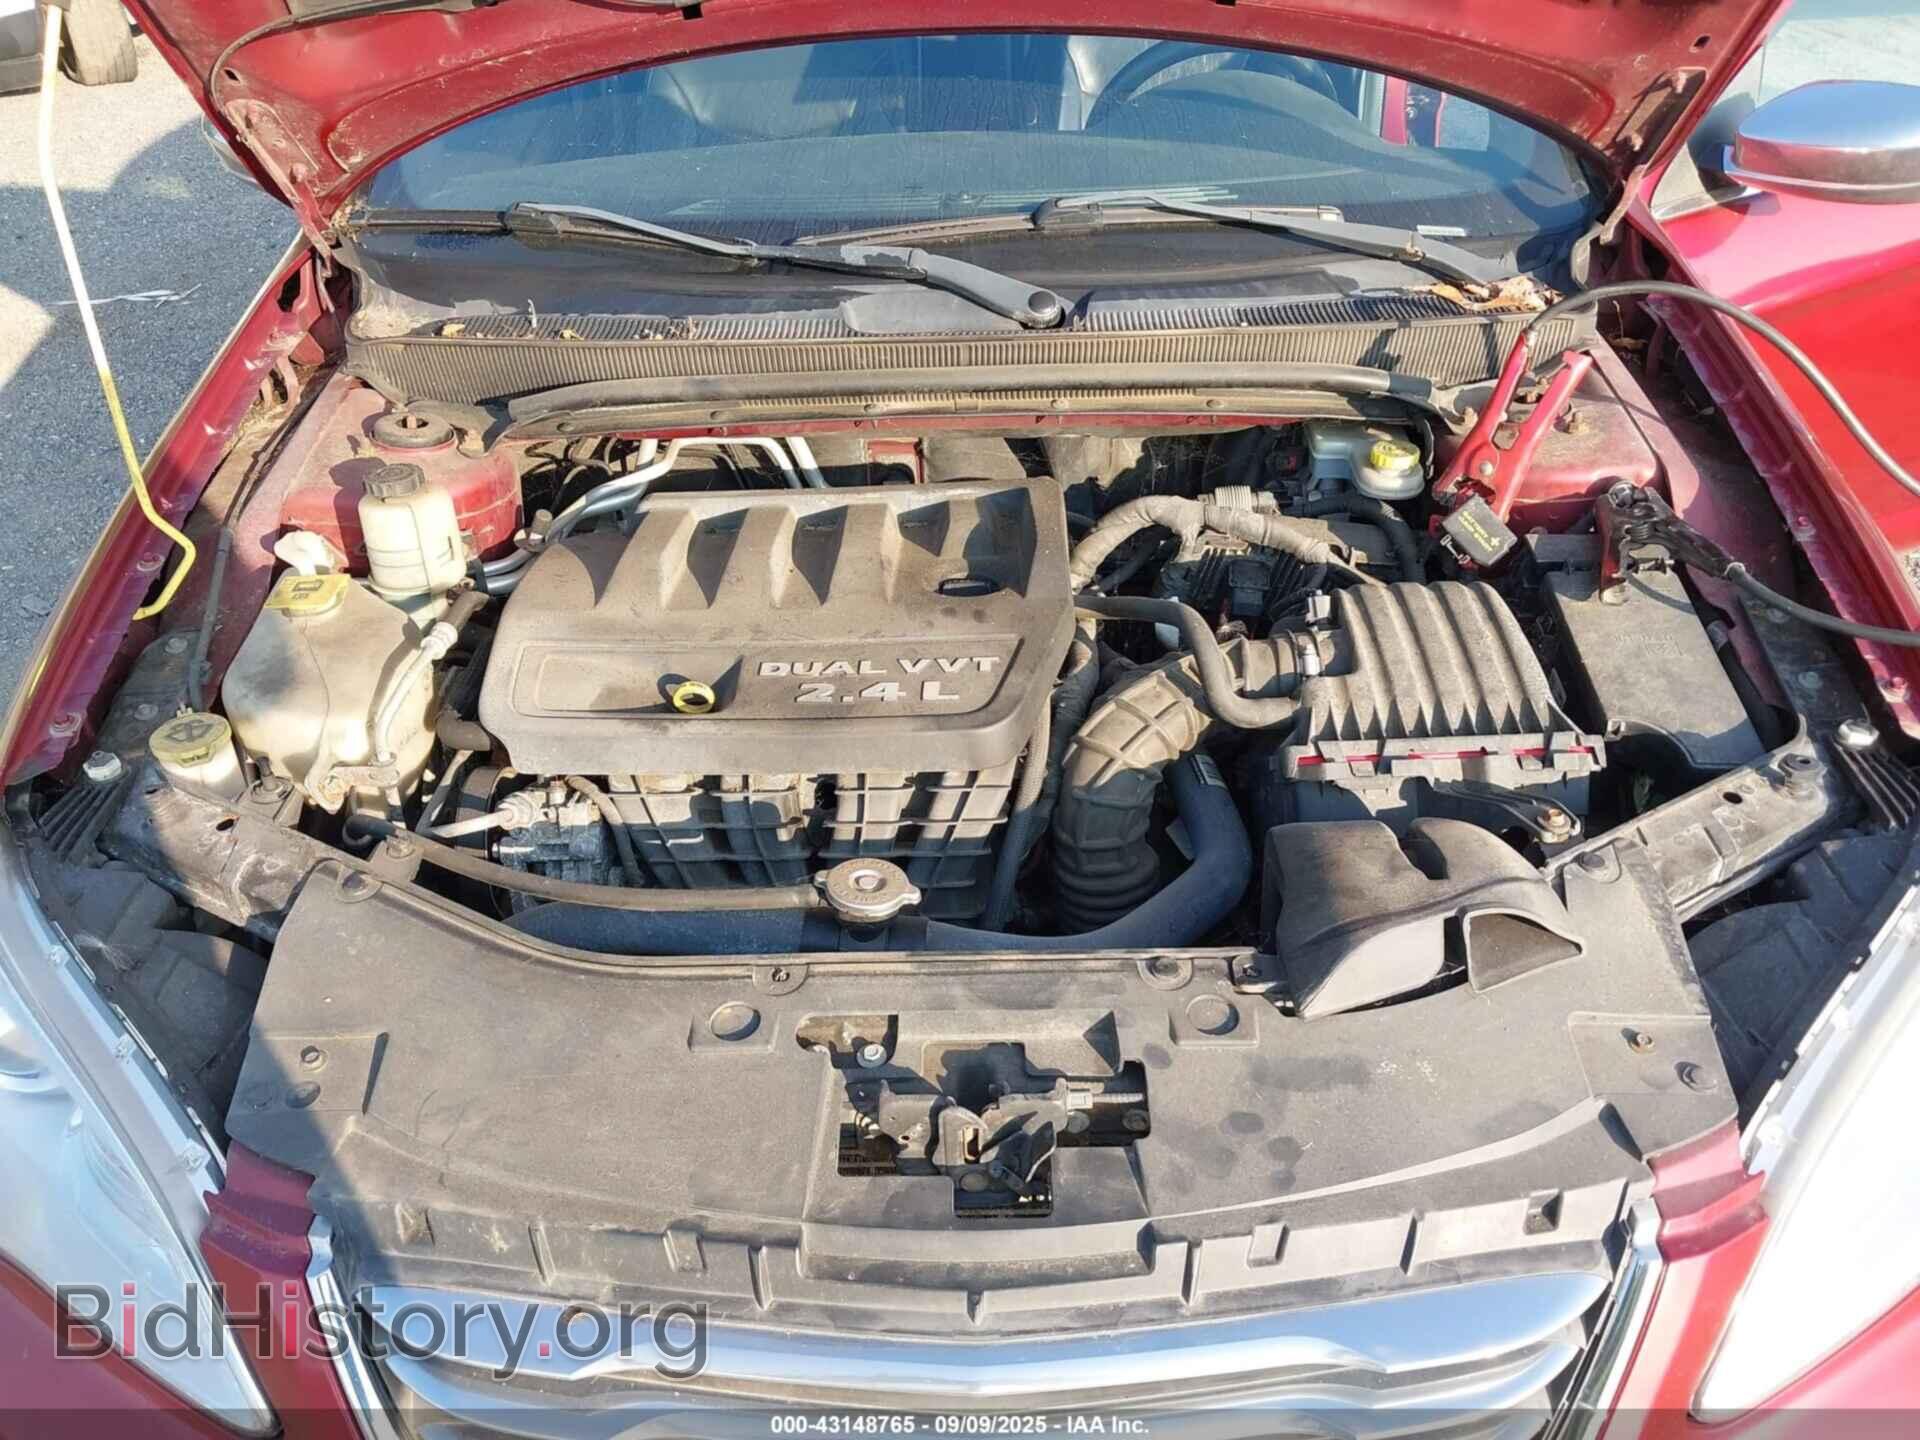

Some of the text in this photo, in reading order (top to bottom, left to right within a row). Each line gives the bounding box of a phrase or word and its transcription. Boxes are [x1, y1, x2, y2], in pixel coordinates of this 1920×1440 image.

[757, 655, 1000, 677] DUAL VVT
[794, 679, 961, 704] 2.4 L
